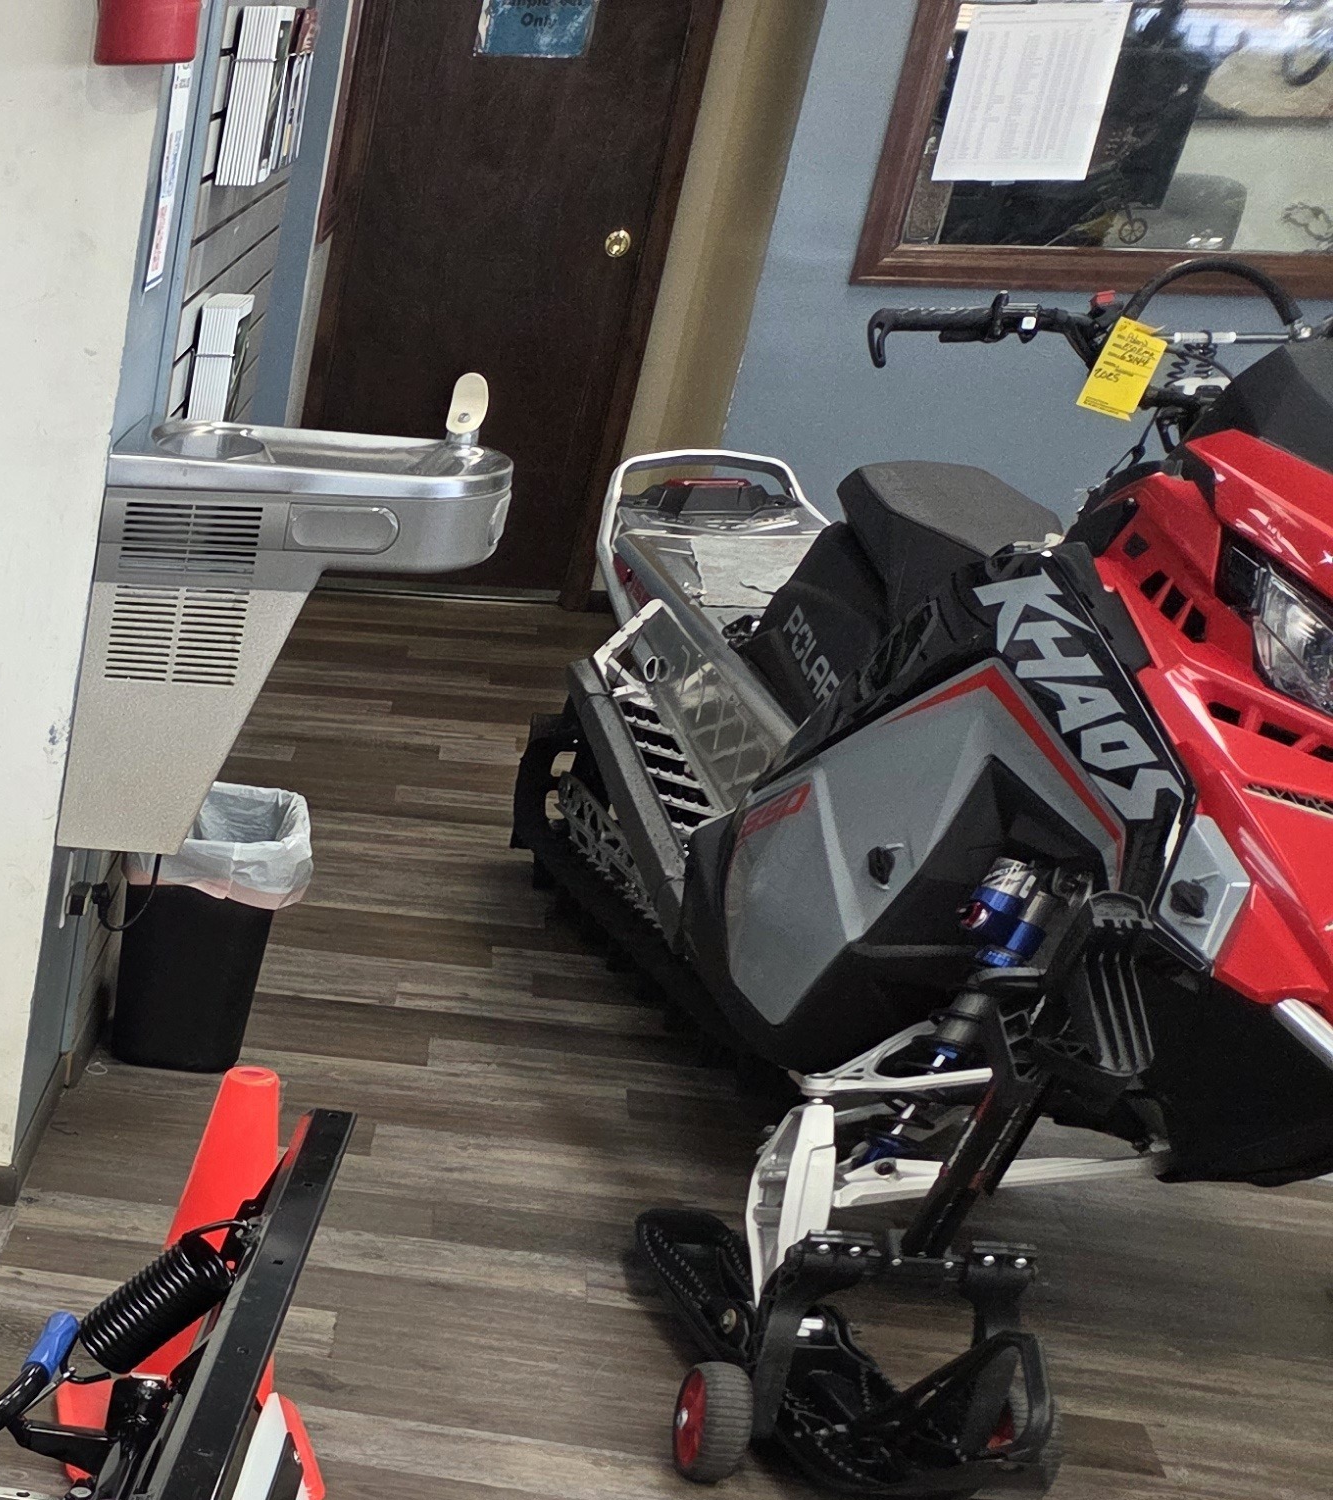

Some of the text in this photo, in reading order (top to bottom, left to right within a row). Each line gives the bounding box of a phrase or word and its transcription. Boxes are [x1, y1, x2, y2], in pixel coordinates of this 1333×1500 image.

[520, 12, 557, 28] Only
[783, 604, 841, 700] POLAR
[973, 569, 1186, 822] KHAOS
